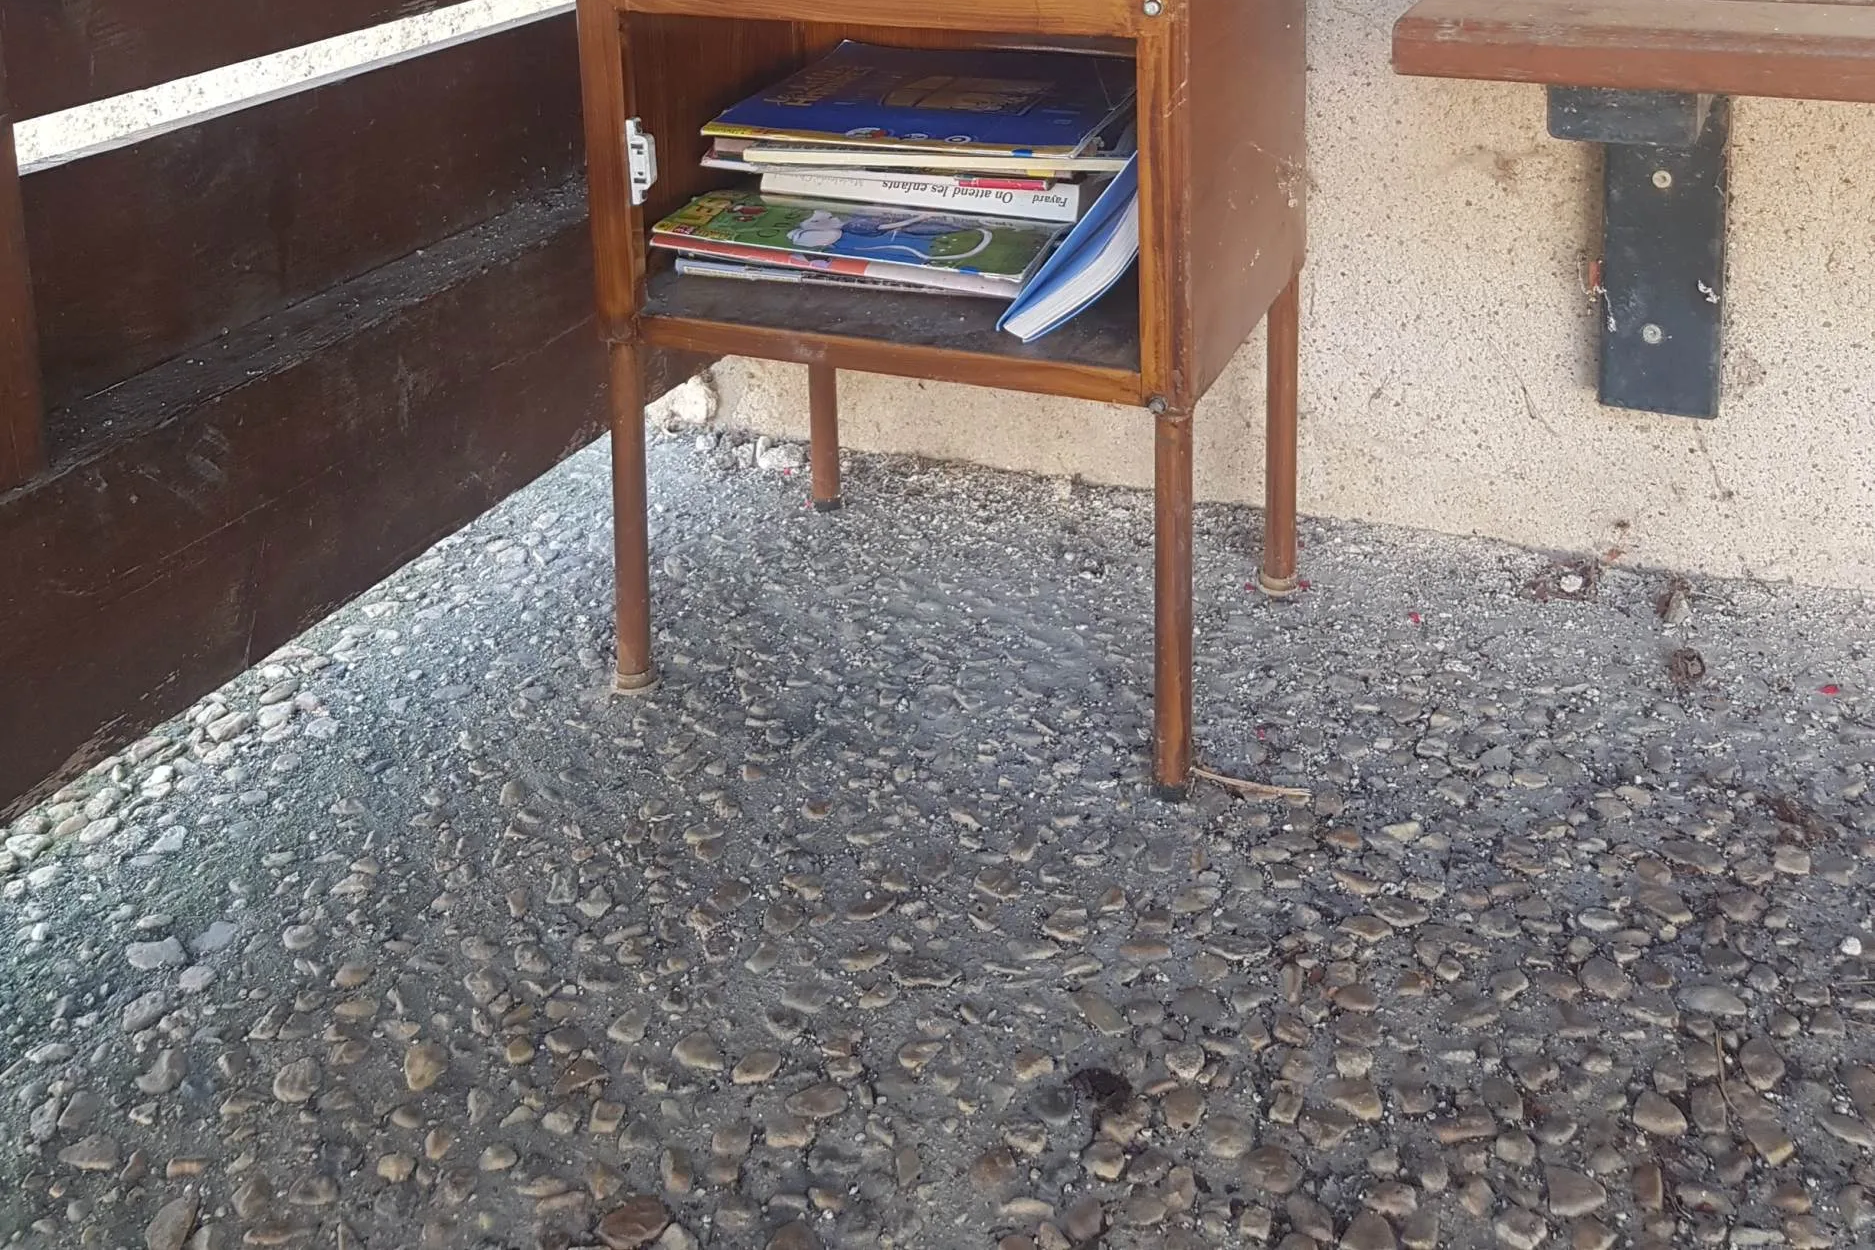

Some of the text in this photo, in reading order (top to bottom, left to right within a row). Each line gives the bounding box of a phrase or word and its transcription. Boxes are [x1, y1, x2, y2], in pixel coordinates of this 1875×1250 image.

[880, 177, 1068, 208] Fayard On attend les enfants
